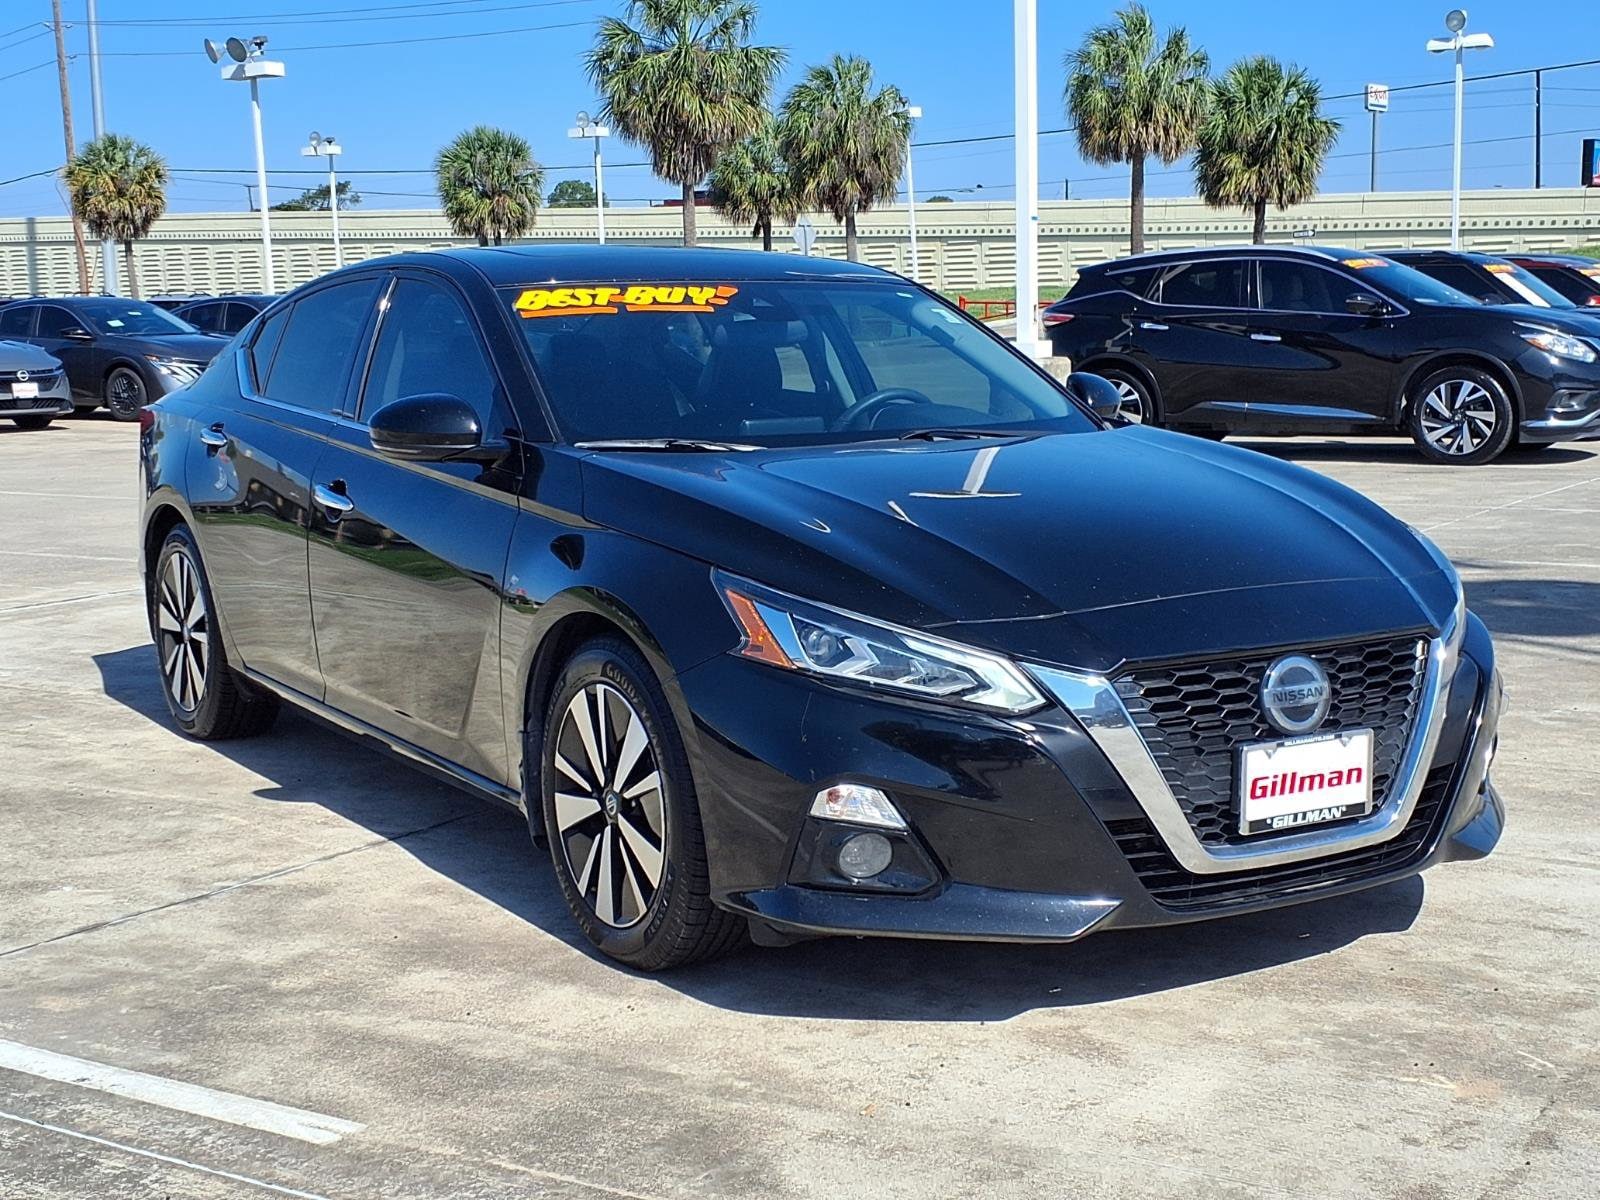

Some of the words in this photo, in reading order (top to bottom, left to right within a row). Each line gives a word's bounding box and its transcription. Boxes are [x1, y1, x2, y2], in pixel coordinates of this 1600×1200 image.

[514, 287, 621, 311] BEST
[1272, 686, 1323, 703] NISSAN
[1250, 766, 1363, 800] Gillman
[1271, 806, 1343, 829] GILLMAN
